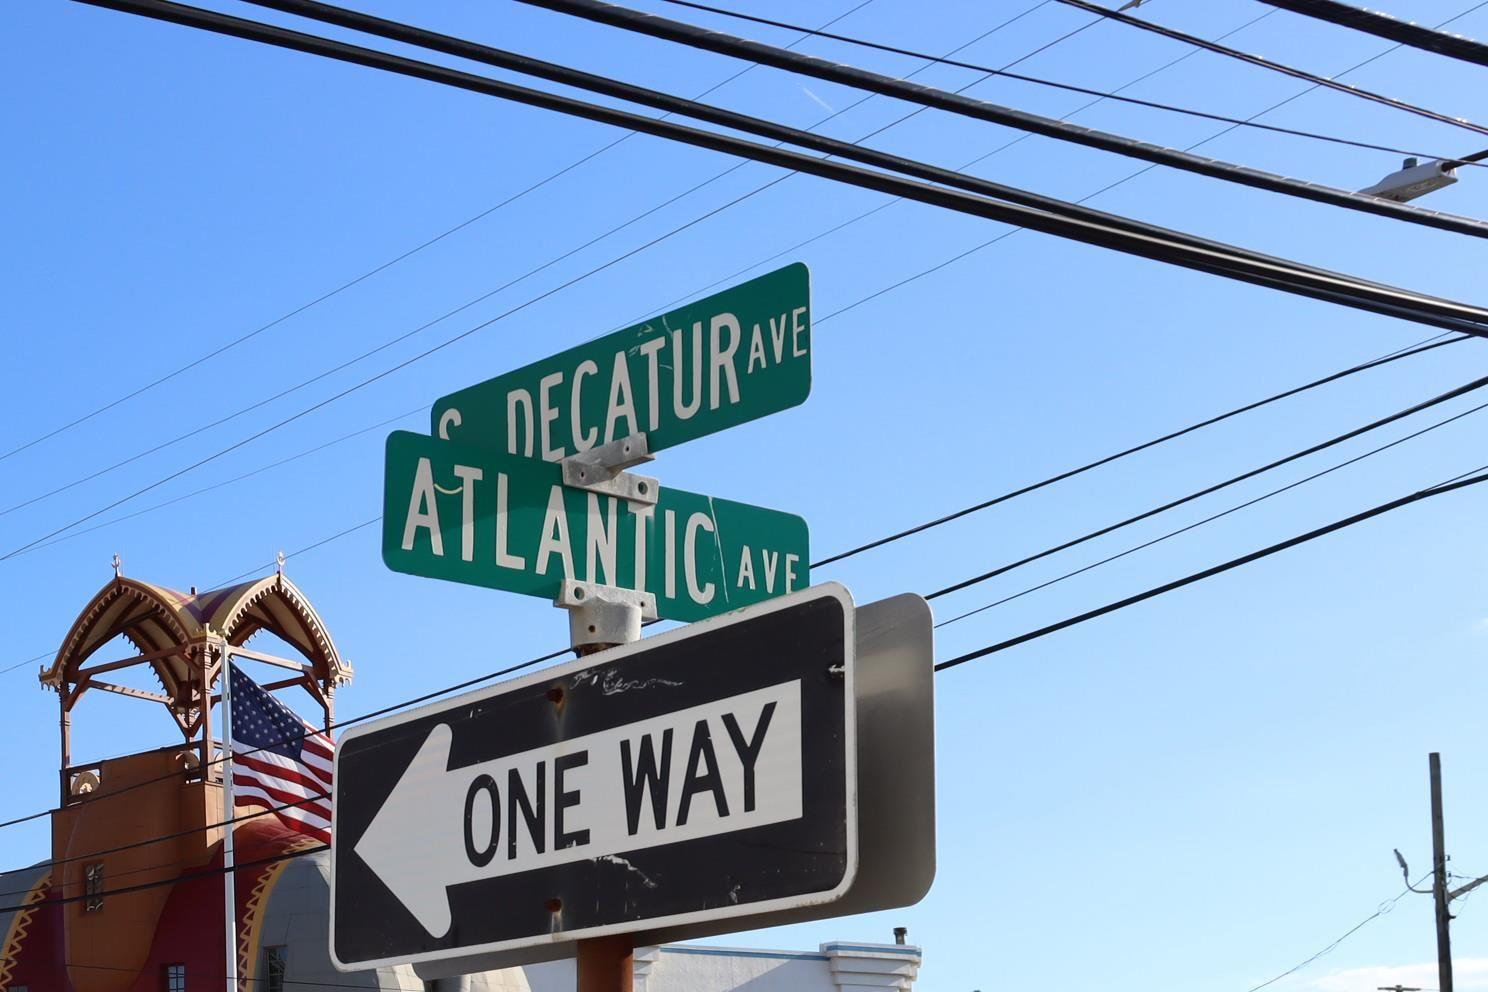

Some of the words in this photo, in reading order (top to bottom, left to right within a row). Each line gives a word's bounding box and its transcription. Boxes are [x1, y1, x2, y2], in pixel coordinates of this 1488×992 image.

[507, 312, 741, 463] DECATUR
[748, 305, 809, 374] AVE
[401, 457, 716, 604] ATLANTIC
[737, 550, 801, 596] AVE
[463, 749, 591, 869] ONE
[620, 701, 779, 837] WAY
